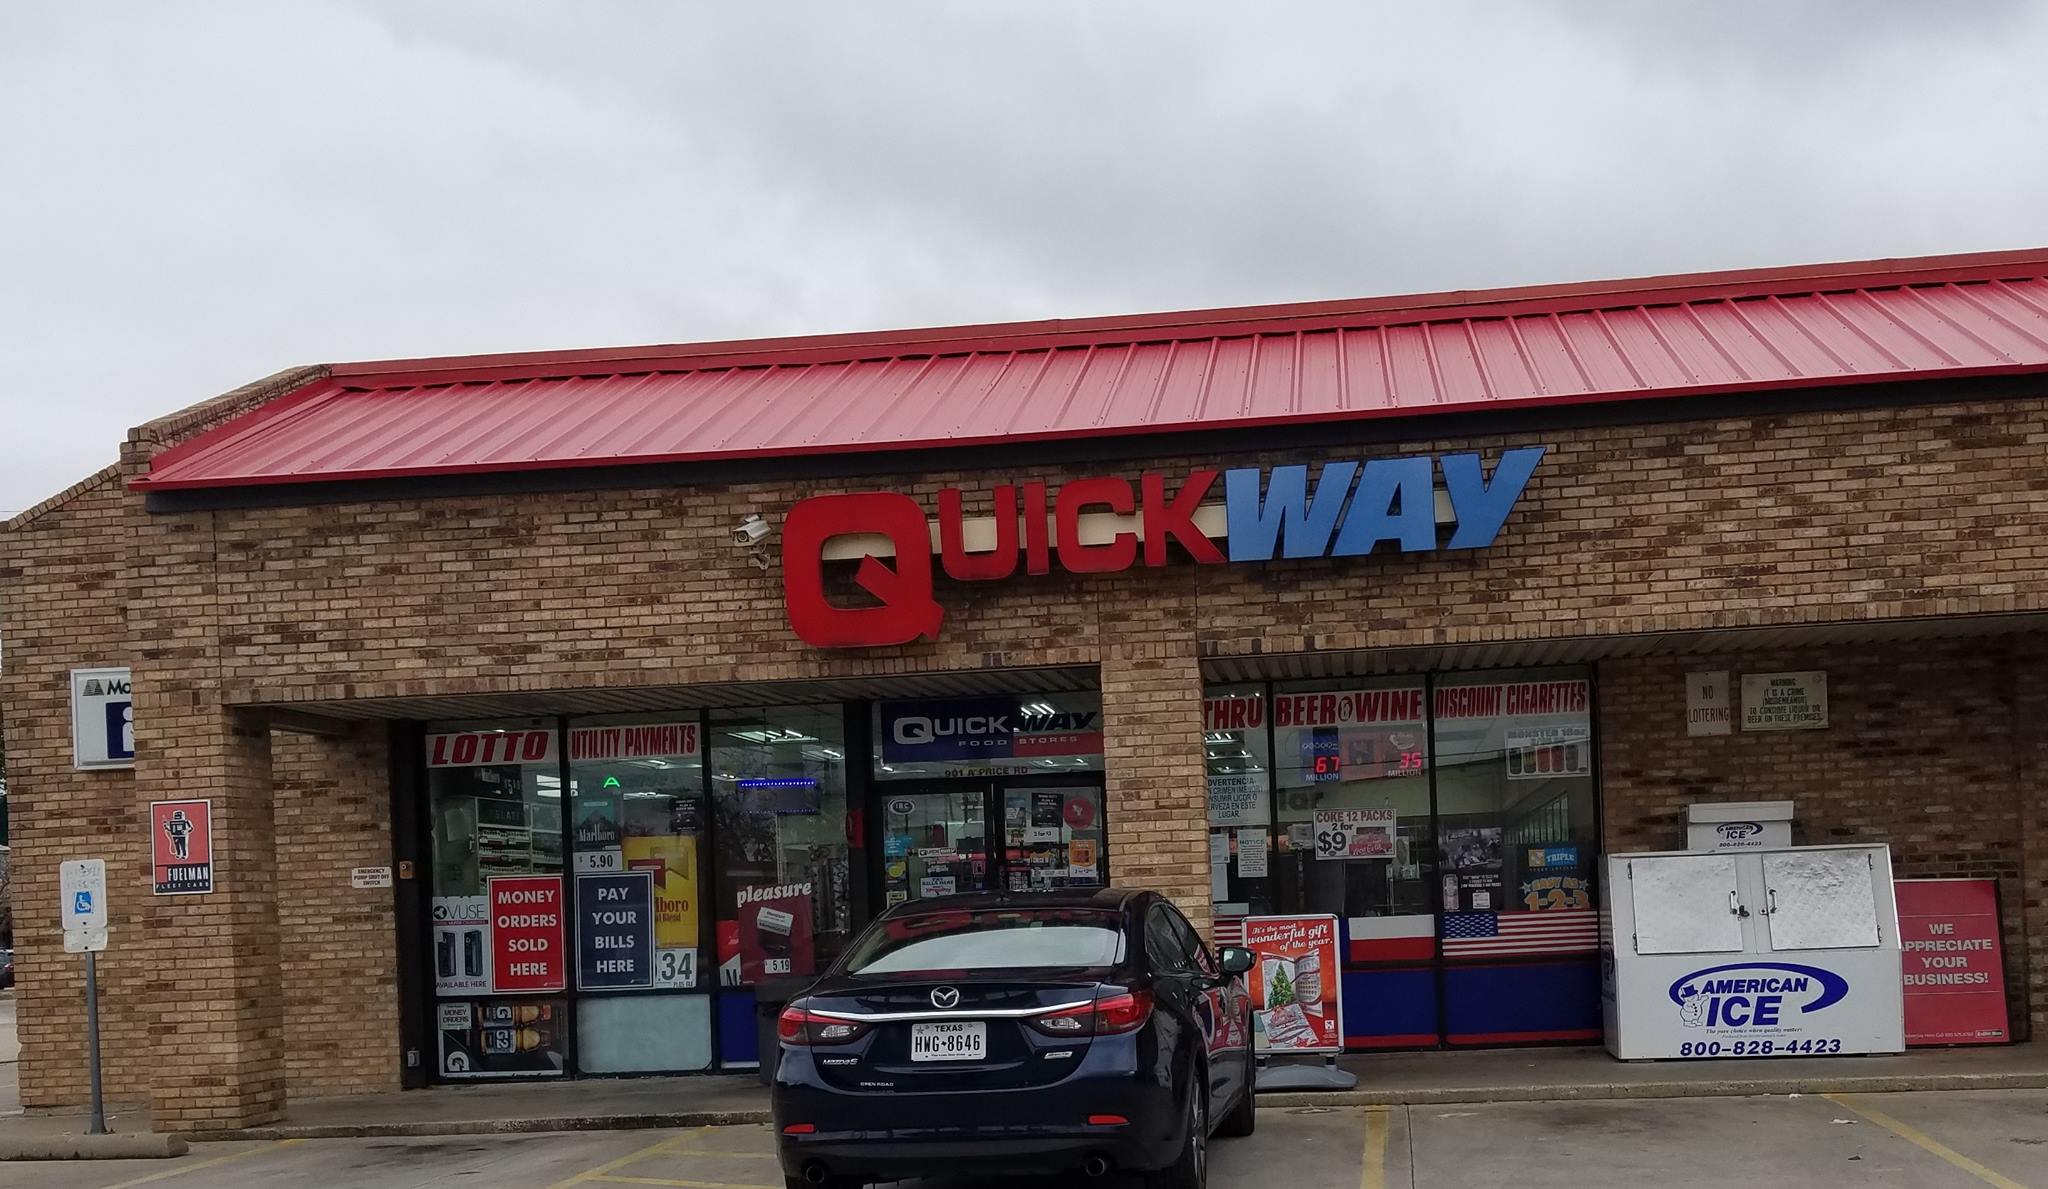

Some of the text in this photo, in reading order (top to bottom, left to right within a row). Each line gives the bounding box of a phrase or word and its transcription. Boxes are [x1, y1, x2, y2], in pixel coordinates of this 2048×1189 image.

[1702, 685, 1714, 699] NO
[1435, 682, 1586, 718] DISCOUNT CIGARETTES
[1276, 690, 1423, 727] BEER WINE
[1688, 707, 1729, 723] LOITERING
[893, 716, 1010, 745] QUICK
[432, 732, 549, 765] LOTTO
[571, 724, 696, 760] UTILITY PAYMENTS
[958, 736, 1078, 747] FOOD STORES
[1400, 752, 1423, 769] 35
[1014, 766, 1028, 774] RD
[1388, 768, 1422, 777] MILLION
[1305, 773, 1339, 782] MILLION
[1208, 802, 1231, 811] ERVEZA
[1317, 809, 1393, 823] COKE 12 PACKS
[579, 824, 615, 842] Marlboro
[1331, 822, 1354, 831] 2 for
[1726, 830, 1747, 839] ICE
[1318, 830, 1347, 855] $9
[167, 866, 209, 881] FUELMAN
[498, 890, 555, 904] MONEY
[598, 887, 629, 901] PAY
[736, 881, 813, 908] pleasure
[447, 904, 485, 919] VUSE
[592, 911, 637, 925] YOUR
[497, 914, 557, 928] ORDERS
[1248, 924, 1329, 945] wonderful gift
[1928, 923, 1955, 935] WE
[508, 938, 549, 952] SOLD
[594, 935, 635, 949] BILLS
[1280, 941, 1289, 952] of
[1292, 940, 1306, 948] the
[510, 962, 548, 976] HERE
[596, 959, 634, 974] HERE
[1921, 956, 1968, 968] YOUR
[436, 980, 487, 989] AVAILABLE HERE
[1701, 977, 1808, 994] AMERICAN
[1903, 972, 1989, 986] BUSINESS!
[1706, 995, 1783, 1027] ICE
[934, 1024, 963, 1032] TEXAS
[1680, 1039, 1842, 1056] 800-828-4423
